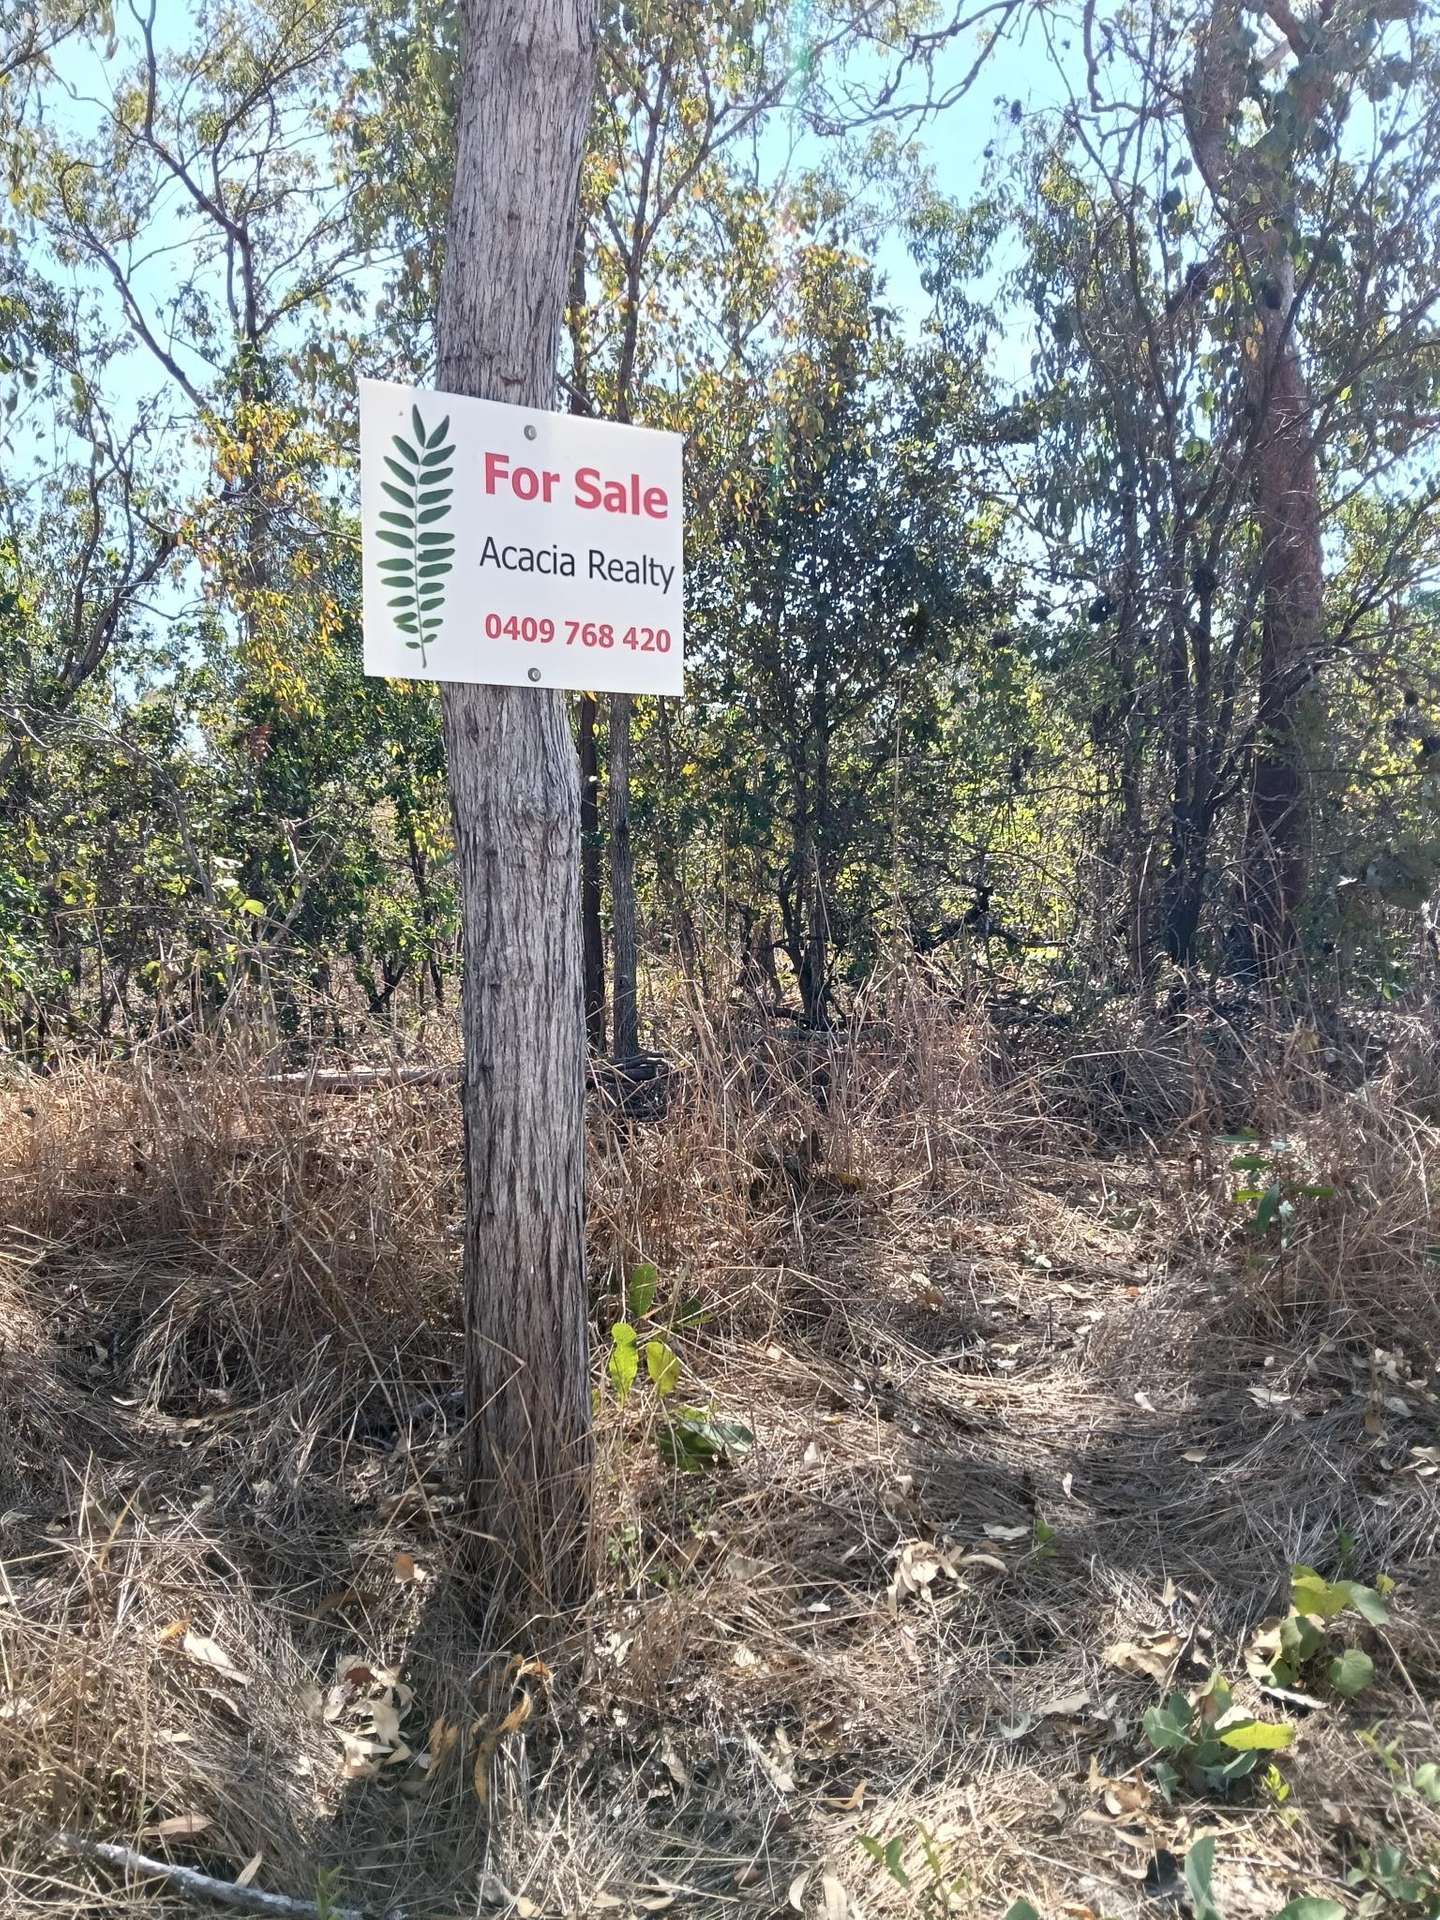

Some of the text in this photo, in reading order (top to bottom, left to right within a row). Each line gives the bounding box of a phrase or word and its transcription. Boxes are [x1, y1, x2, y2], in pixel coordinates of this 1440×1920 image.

[485, 452, 668, 519] For Sale
[479, 536, 675, 594] Acacia Realty
[485, 613, 671, 653] 0409 768 420
